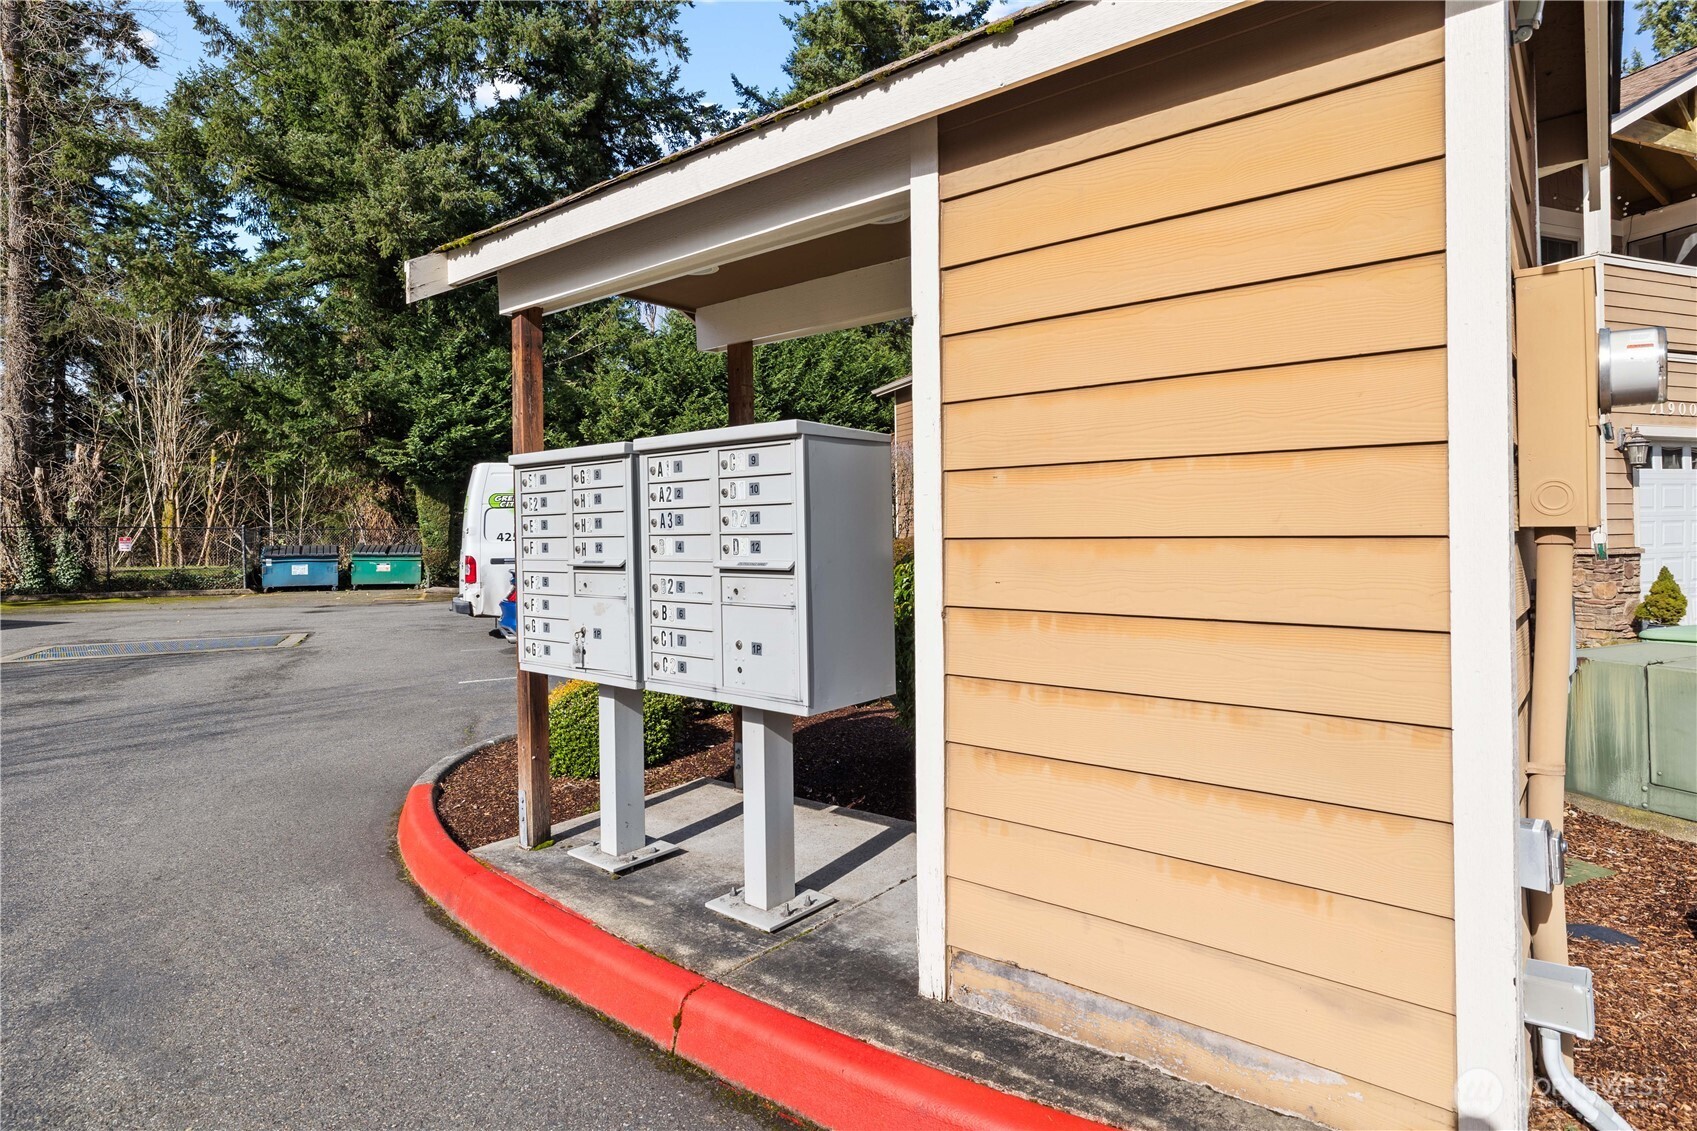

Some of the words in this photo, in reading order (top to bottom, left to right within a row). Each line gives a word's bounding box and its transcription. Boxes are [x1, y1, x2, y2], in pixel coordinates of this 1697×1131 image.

[730, 452, 746, 471] C
[658, 486, 672, 502] A2
[529, 497, 538, 512] E2
[660, 512, 673, 529] A3
[732, 538, 748, 556] D
[661, 630, 673, 648] C1
[752, 644, 762, 654] 1P
